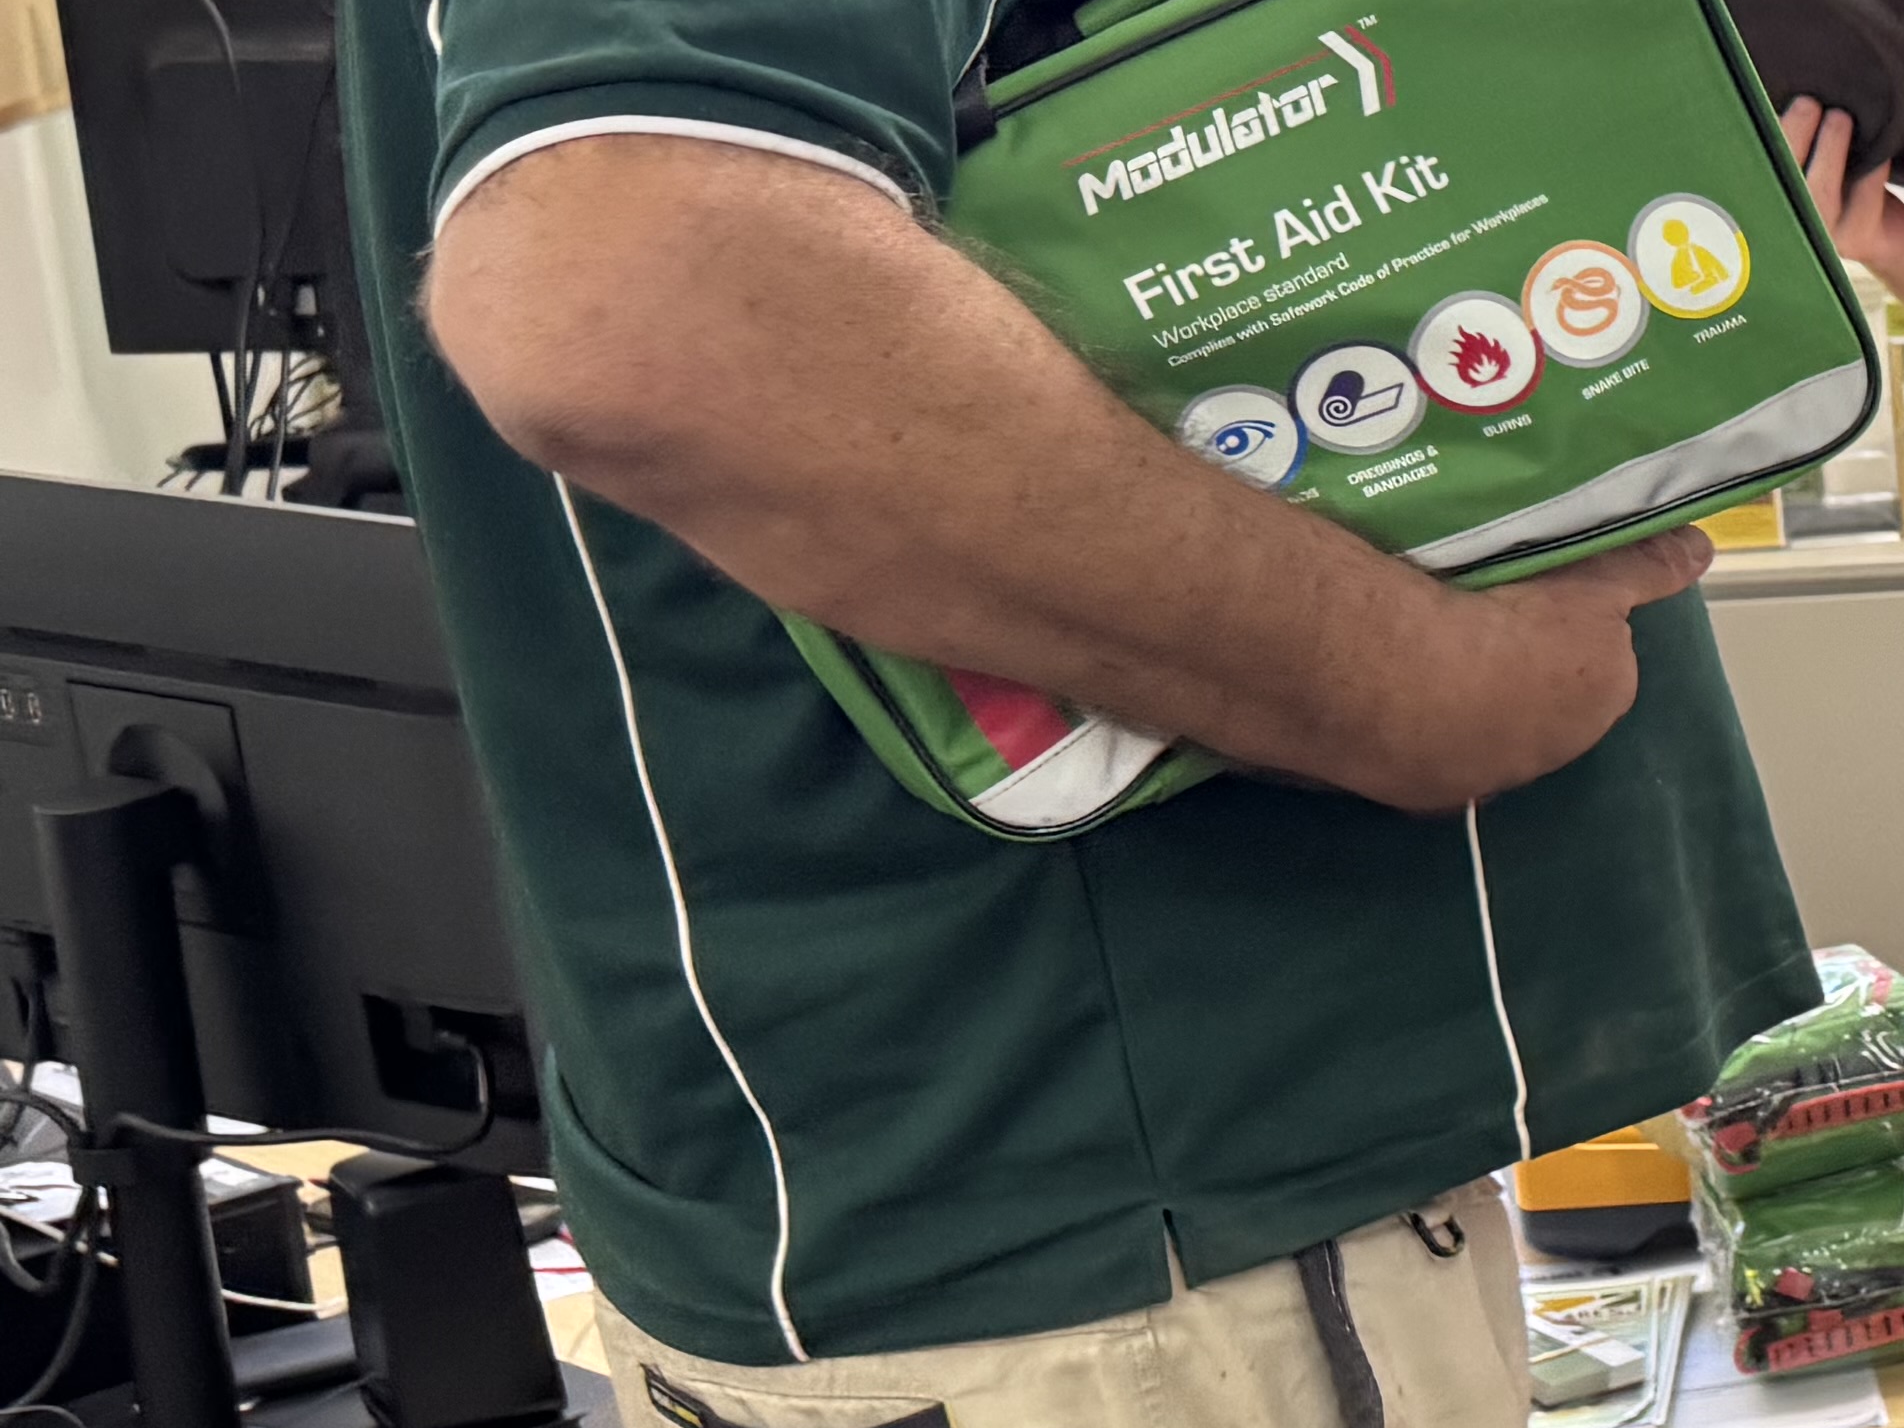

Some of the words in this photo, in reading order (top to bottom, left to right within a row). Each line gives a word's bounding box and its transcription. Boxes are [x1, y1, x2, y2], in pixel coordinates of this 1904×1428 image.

[1078, 73, 1339, 217] Modulator
[1123, 236, 1266, 320] First
[1272, 183, 1362, 260] Aid
[1361, 154, 1450, 215] Kit
[1152, 293, 1263, 351] Workplace
[1262, 251, 1350, 303] standard
[1167, 334, 1237, 368] Complies
[1236, 320, 1271, 343] with
[1270, 288, 1339, 328] Safework
[1338, 273, 1377, 299] Code
[1377, 263, 1392, 280] of
[1391, 238, 1451, 273] Practice
[1450, 228, 1472, 246] for
[1469, 193, 1550, 236] Workplaces
[1691, 313, 1748, 345] TRAUMA
